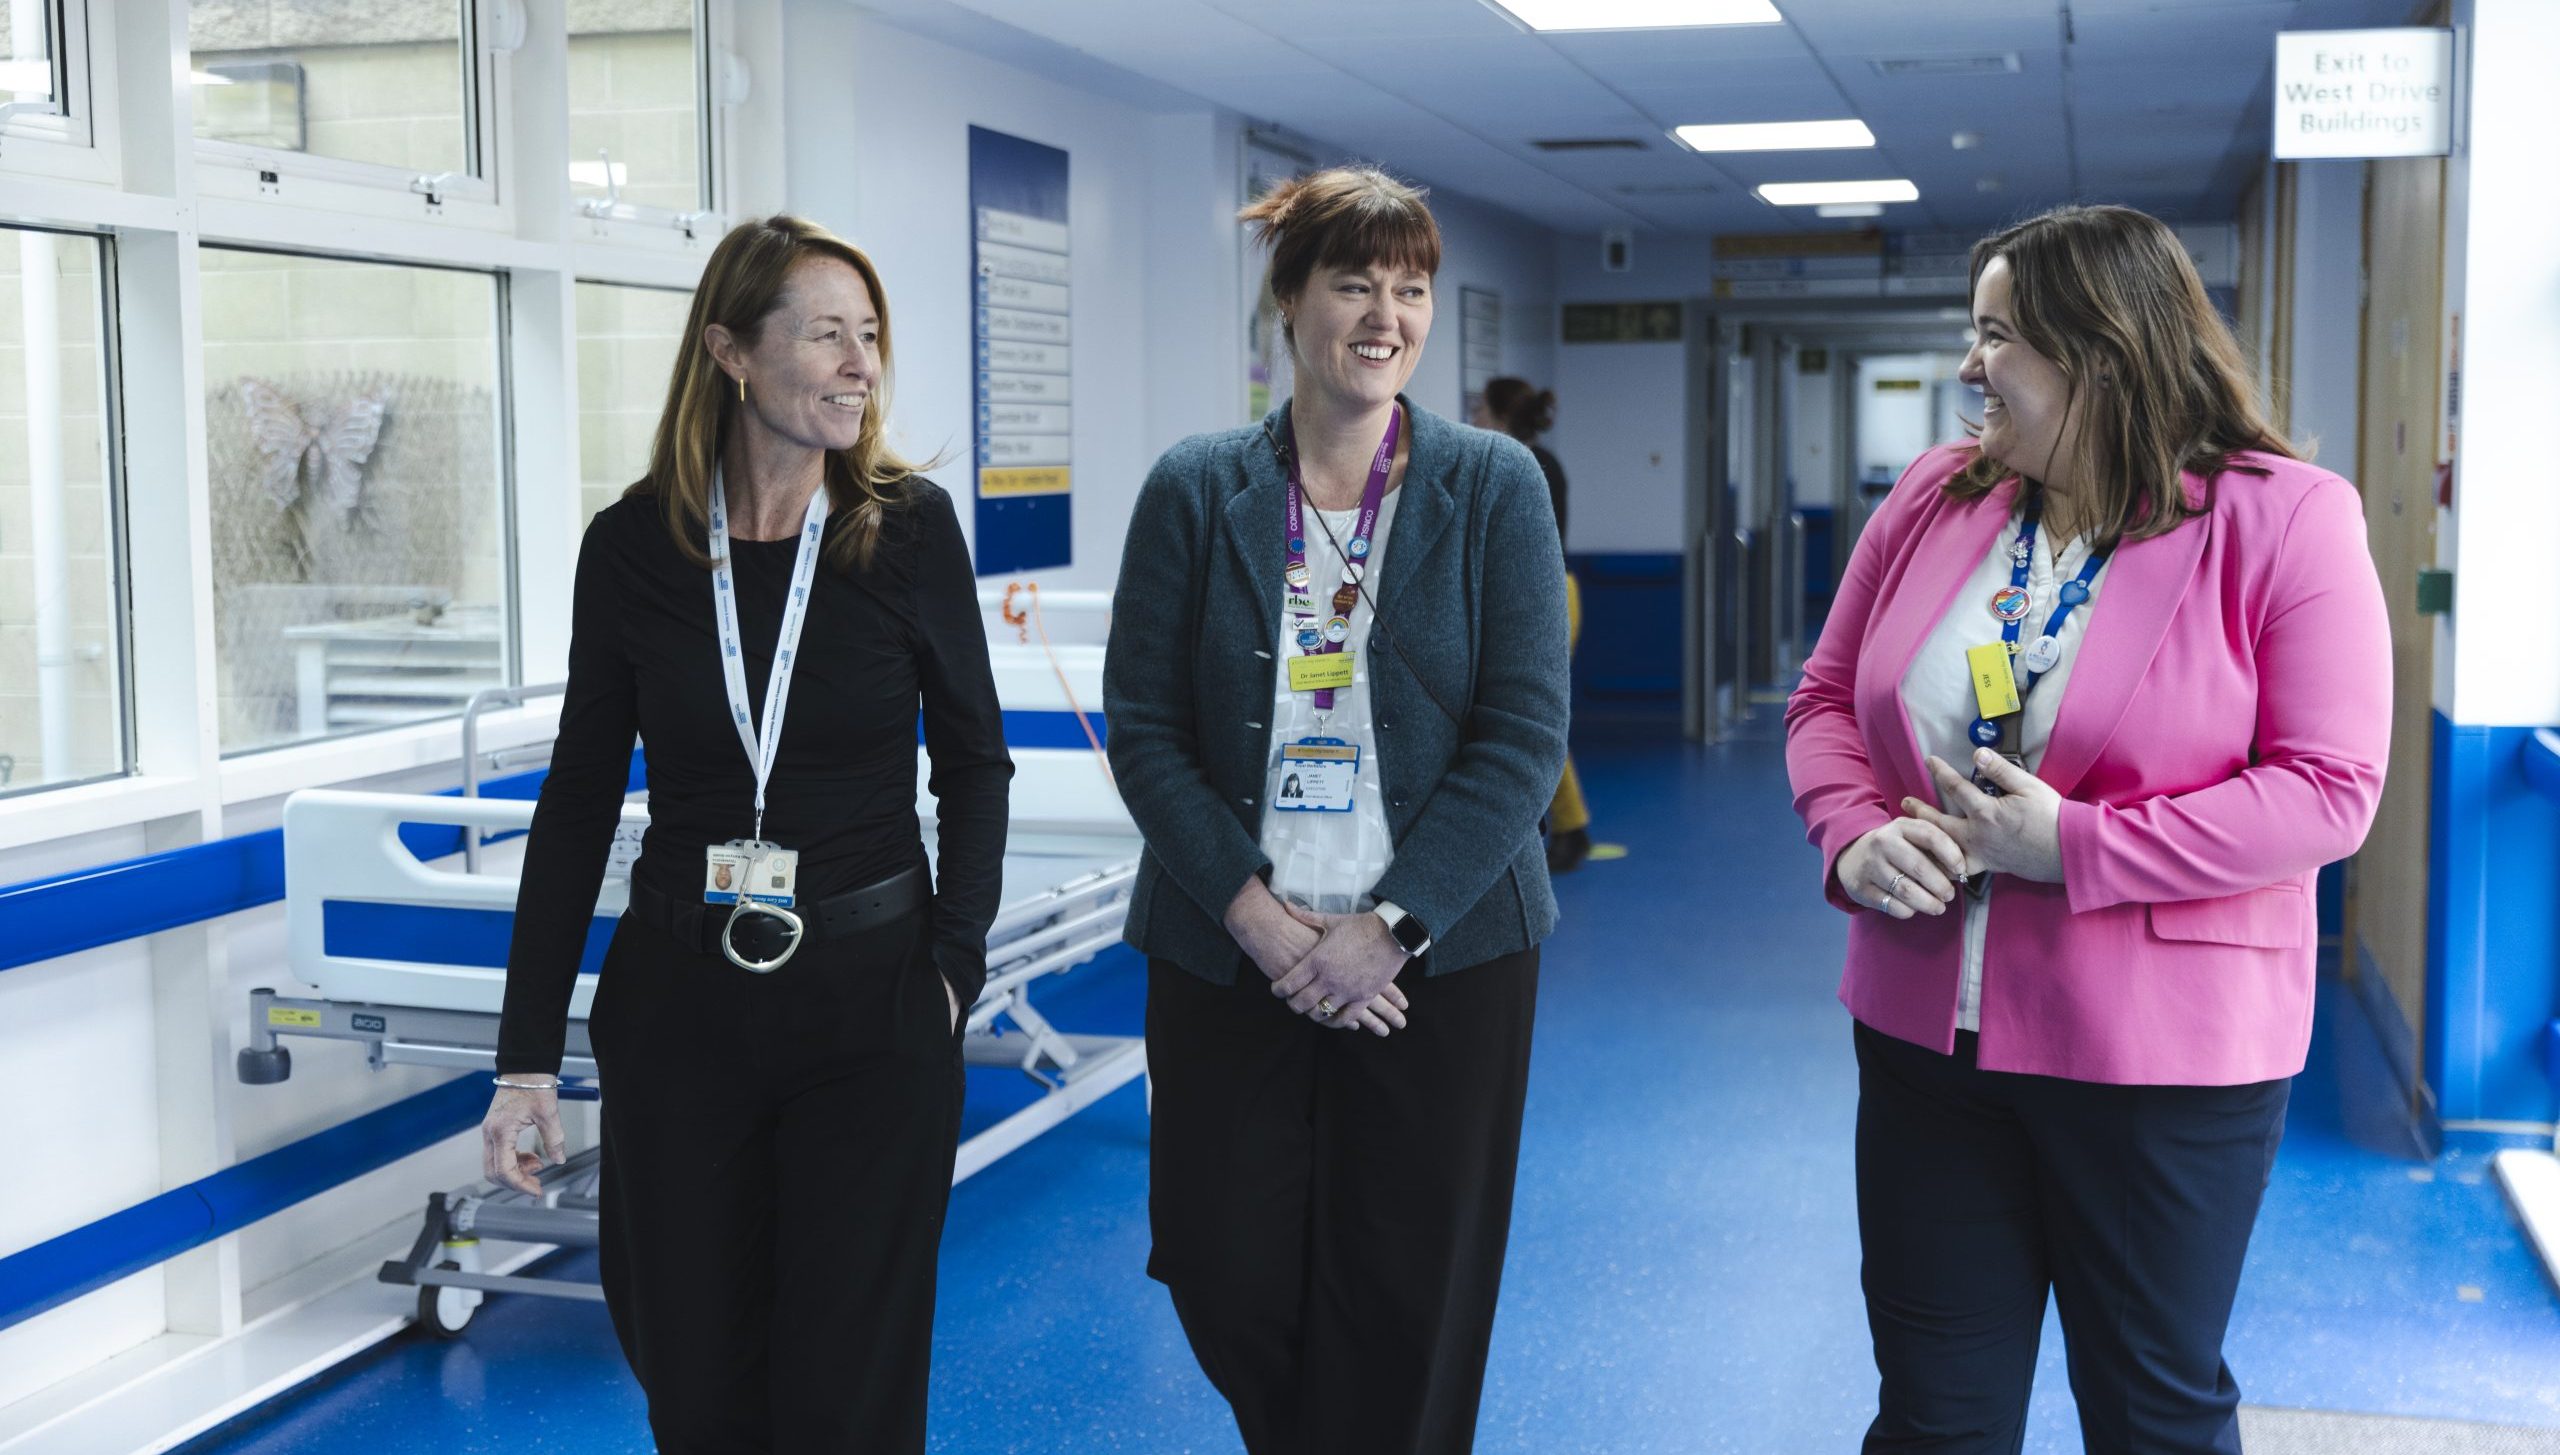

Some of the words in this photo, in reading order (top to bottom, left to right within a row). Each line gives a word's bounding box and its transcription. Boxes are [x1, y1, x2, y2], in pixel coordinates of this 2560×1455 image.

[2315, 51, 2365, 74] Exit
[2384, 53, 2410, 73] to
[2285, 83, 2354, 103] West
[2369, 82, 2442, 103] Drive
[2300, 112, 2423, 137] Buildings
[1288, 481, 1298, 532] CONSULTANT
[1310, 671, 1326, 679] Janet
[1327, 669, 1349, 679] Lippett
[1983, 674, 1992, 688] JESS
